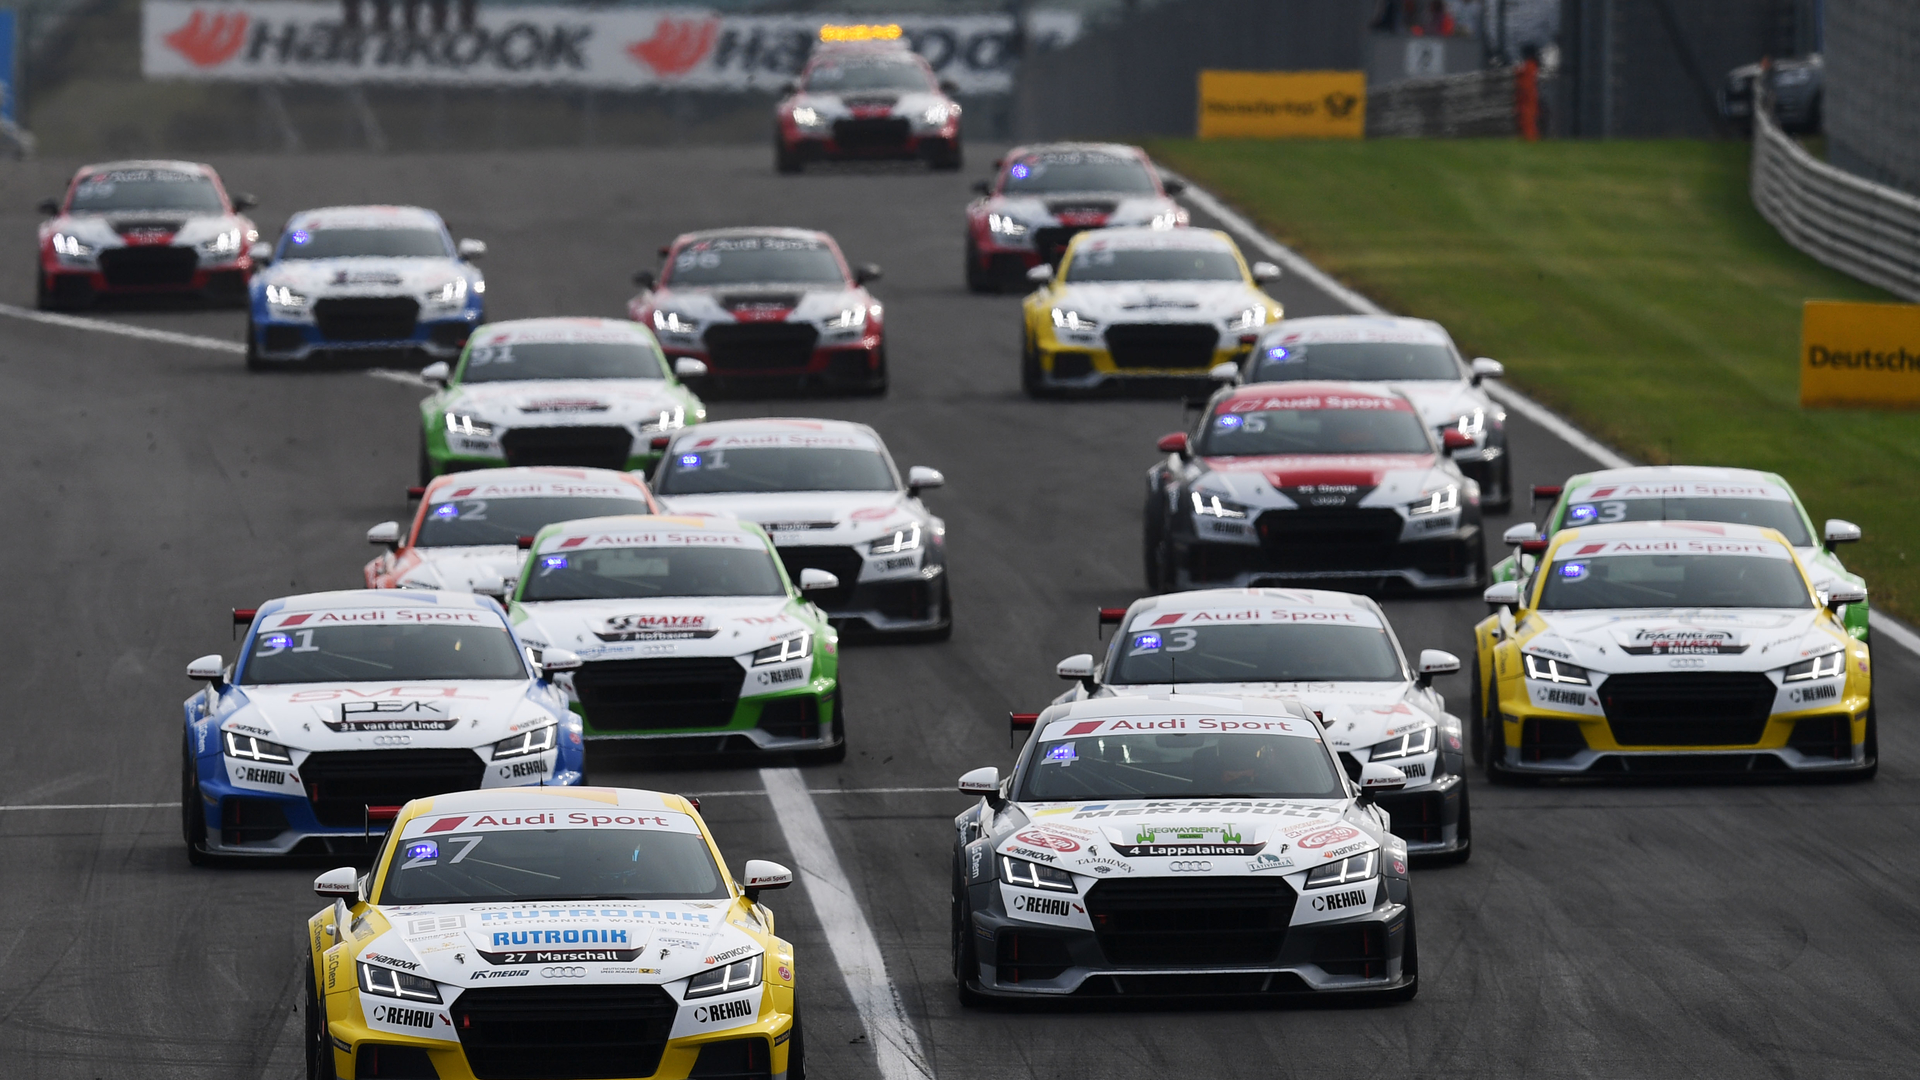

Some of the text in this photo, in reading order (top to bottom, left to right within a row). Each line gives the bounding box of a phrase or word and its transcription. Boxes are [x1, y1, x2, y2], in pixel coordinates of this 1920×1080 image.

[1809, 345, 1920, 372] Deutsch
[593, 533, 743, 547] Audi Sport
[1613, 540, 1768, 555] Audi Sport
[317, 610, 481, 624] Audi Sport
[638, 616, 705, 625] MAYER
[1190, 609, 1357, 624] Audi Sport
[255, 629, 320, 658] 31
[1129, 628, 1198, 657] 23
[1669, 646, 1718, 655] Nielsen
[1548, 687, 1586, 706] REHAU
[341, 720, 446, 731] 31 van der Linde
[1109, 718, 1293, 733] Audi Sport
[1040, 741, 1080, 768] 4
[246, 767, 285, 785] REHAU
[512, 758, 548, 778] REHAU
[472, 812, 670, 828] Audi Sport
[1072, 806, 1323, 820] MERITUULI
[401, 835, 484, 871] 27
[1129, 845, 1245, 857] 4 Lappalainen
[1075, 857, 1135, 874] TAMMINEN
[1026, 896, 1071, 917] REHAU
[1326, 889, 1367, 911] REHAU
[480, 909, 710, 923] RUTRONIK
[482, 918, 711, 930] ELECTRONICS WORLDWIDE
[493, 929, 627, 947] RUTRONIK
[372, 953, 421, 971] Hankook
[504, 951, 619, 963] 27 Marschall
[328, 961, 340, 989] Chem
[386, 1007, 435, 1029] REHAU
[708, 999, 752, 1023] REHAU
